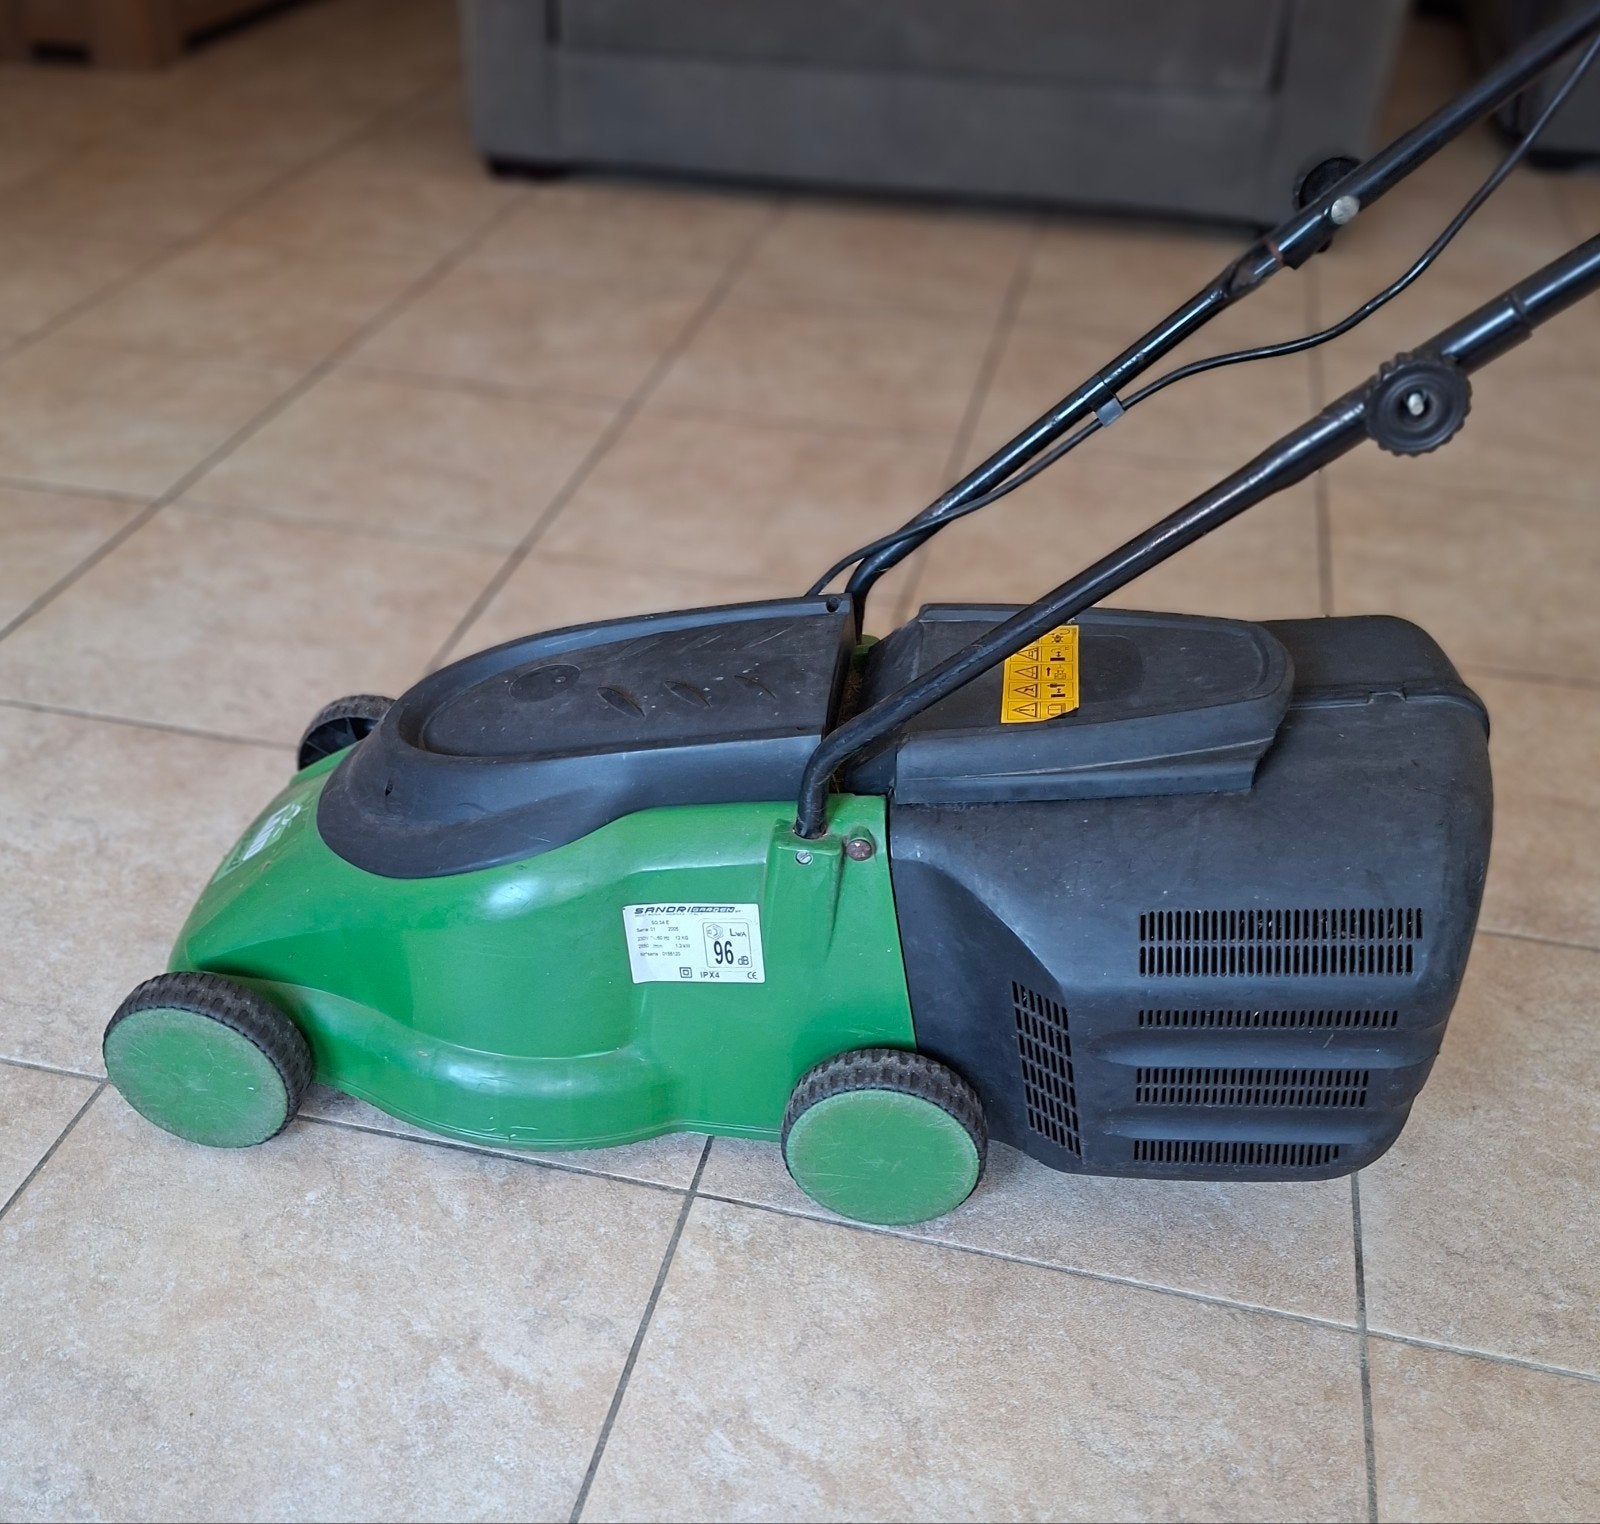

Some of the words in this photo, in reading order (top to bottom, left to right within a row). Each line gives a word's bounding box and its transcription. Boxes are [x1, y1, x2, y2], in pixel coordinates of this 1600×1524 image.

[635, 906, 691, 914] SANDRI
[713, 940, 734, 965] 96
[738, 955, 750, 966] dB
[700, 971, 720, 979] IPX4
[747, 971, 758, 980] CE
